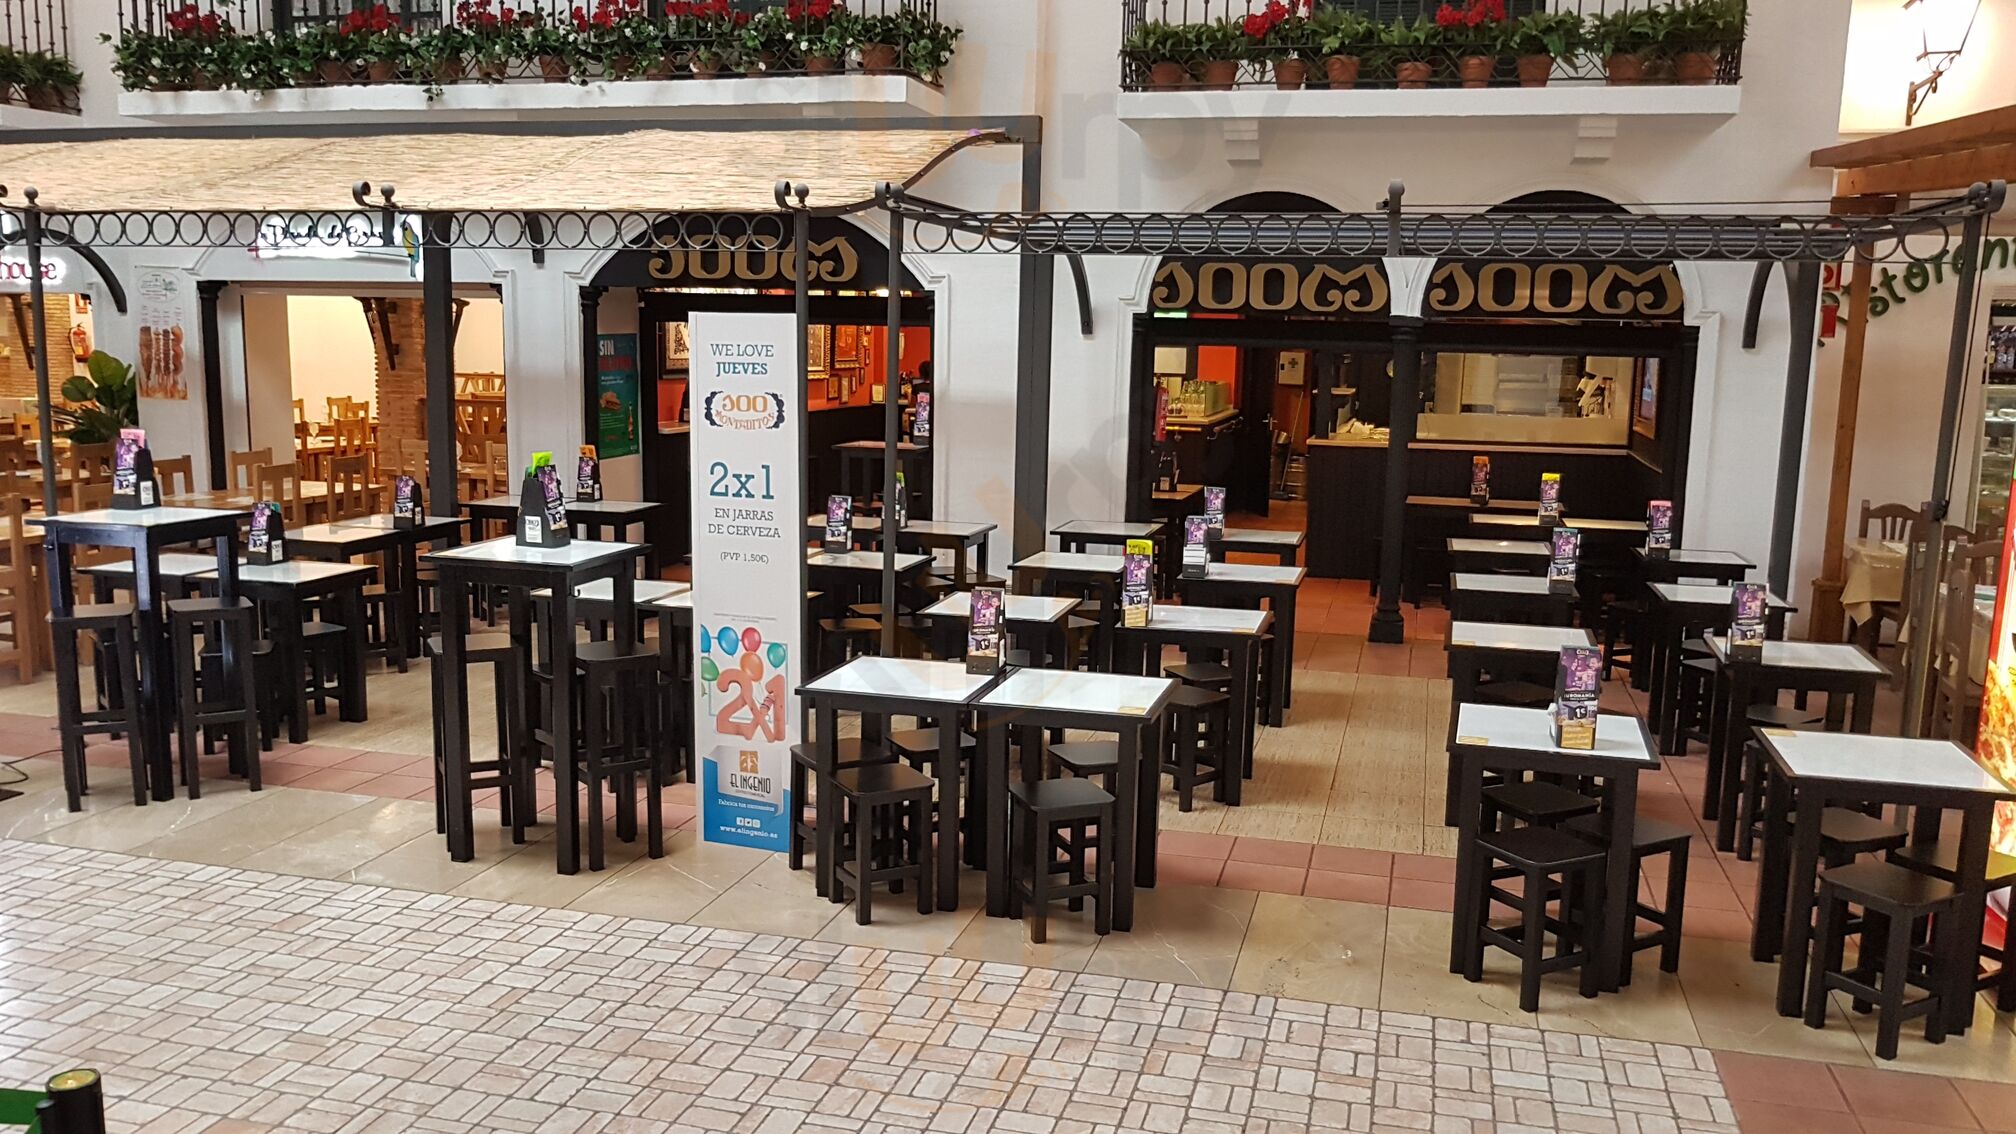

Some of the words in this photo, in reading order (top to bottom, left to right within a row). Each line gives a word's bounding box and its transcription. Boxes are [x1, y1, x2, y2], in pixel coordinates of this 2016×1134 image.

[600, 339, 614, 356] SIN
[710, 343, 734, 357] WE
[737, 344, 774, 357] LOVE
[716, 361, 768, 377] JUEVES
[709, 461, 775, 500] 2x1
[714, 507, 730, 519] EN
[732, 508, 774, 522] JARRAS
[708, 523, 724, 535] DE
[727, 525, 781, 539] CERVEZA
[720, 551, 741, 561] (PVP
[730, 773, 739, 788] EL
[740, 775, 771, 794] INGENIO
